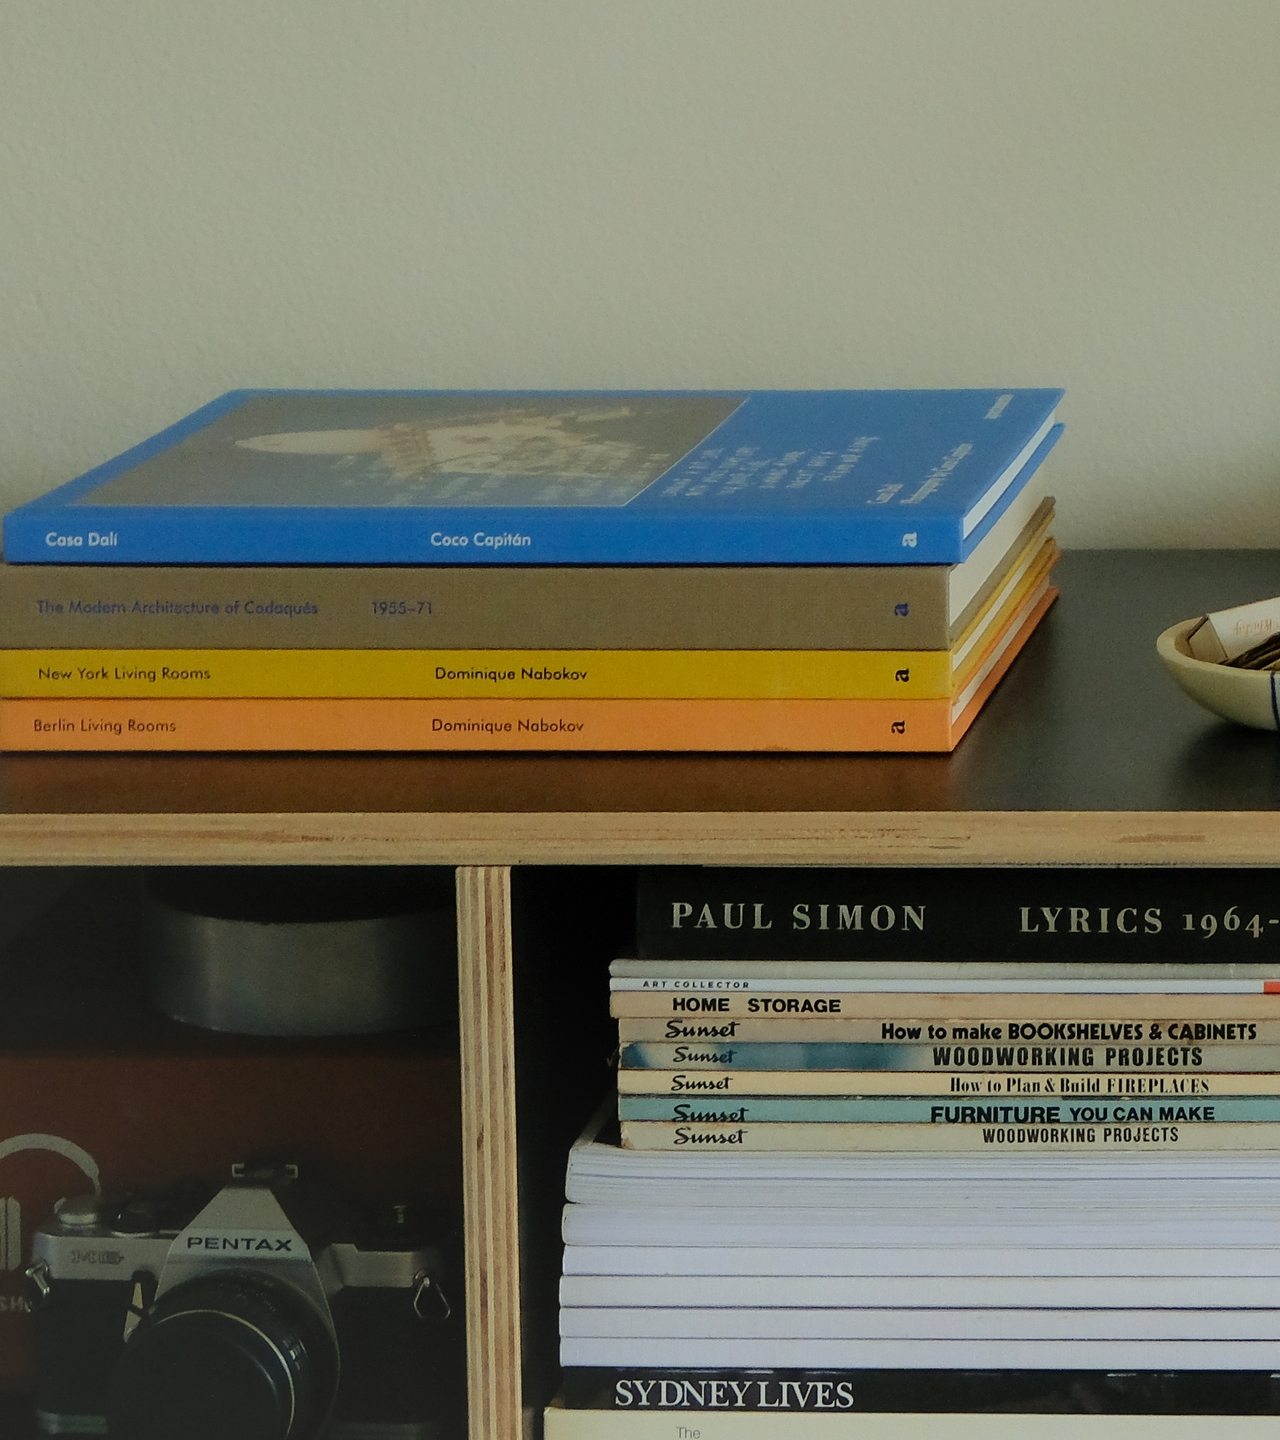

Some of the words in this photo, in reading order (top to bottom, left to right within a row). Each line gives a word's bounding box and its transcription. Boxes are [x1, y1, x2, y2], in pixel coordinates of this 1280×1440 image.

[45, 531, 84, 548] Casa
[87, 530, 118, 548] Dalí
[430, 532, 469, 548] Coco
[473, 531, 532, 550] Capitán
[36, 600, 63, 616] The
[68, 600, 126, 616] Modern
[131, 600, 220, 616] Architecture
[224, 599, 241, 616] of
[244, 600, 319, 620] Cadaqués
[38, 667, 73, 681] New
[76, 666, 109, 681] York
[114, 666, 157, 683] Living
[161, 666, 211, 681] Rooms
[434, 666, 516, 683] Dominique
[520, 666, 589, 681] Nabokov
[33, 718, 75, 733] Berlin
[80, 718, 122, 735] Living
[127, 718, 177, 733] Rooms
[431, 717, 513, 735] Dominique
[517, 718, 585, 733] Nabokov
[670, 901, 774, 931] PAUL
[792, 903, 927, 933] SIMON
[1018, 906, 1164, 935] LYRICS
[642, 980, 668, 989] ART
[673, 980, 751, 990] COLLECTOR
[672, 996, 730, 1013] HOME
[747, 997, 842, 1014] STORAGE
[664, 1019, 741, 1040] Sunset
[881, 1022, 923, 1041] How
[927, 1023, 948, 1041] to
[952, 1022, 1003, 1041] make
[1007, 1022, 1143, 1042] BOOKSHELVES
[1148, 1023, 1163, 1041] &
[1167, 1022, 1258, 1042] CABINETS
[672, 1046, 739, 1064] Sunset
[932, 1046, 1095, 1068] WOODWORKING
[1105, 1046, 1204, 1067] PROJECTS
[670, 1075, 734, 1093] Sunset
[949, 1077, 982, 1093] How
[986, 1079, 1002, 1093] to
[1006, 1077, 1041, 1093] Plan
[1043, 1079, 1056, 1093] &
[1059, 1077, 1101, 1093] Build
[1106, 1077, 1210, 1095] FIREPLACES
[671, 1103, 750, 1123] Sunset
[930, 1105, 1061, 1124] FURNITURE
[1069, 1106, 1109, 1123] YOU
[1112, 1106, 1155, 1122] CAN
[1158, 1105, 1216, 1122] MAKE
[673, 1126, 749, 1146] Sunset
[982, 1127, 1096, 1144] WOODWORKING
[1103, 1126, 1180, 1144] PROJECTS
[186, 1236, 293, 1253] PENTAX
[614, 1379, 753, 1408] SYDNEY
[757, 1381, 855, 1409] LIVES
[675, 1426, 702, 1440] The
